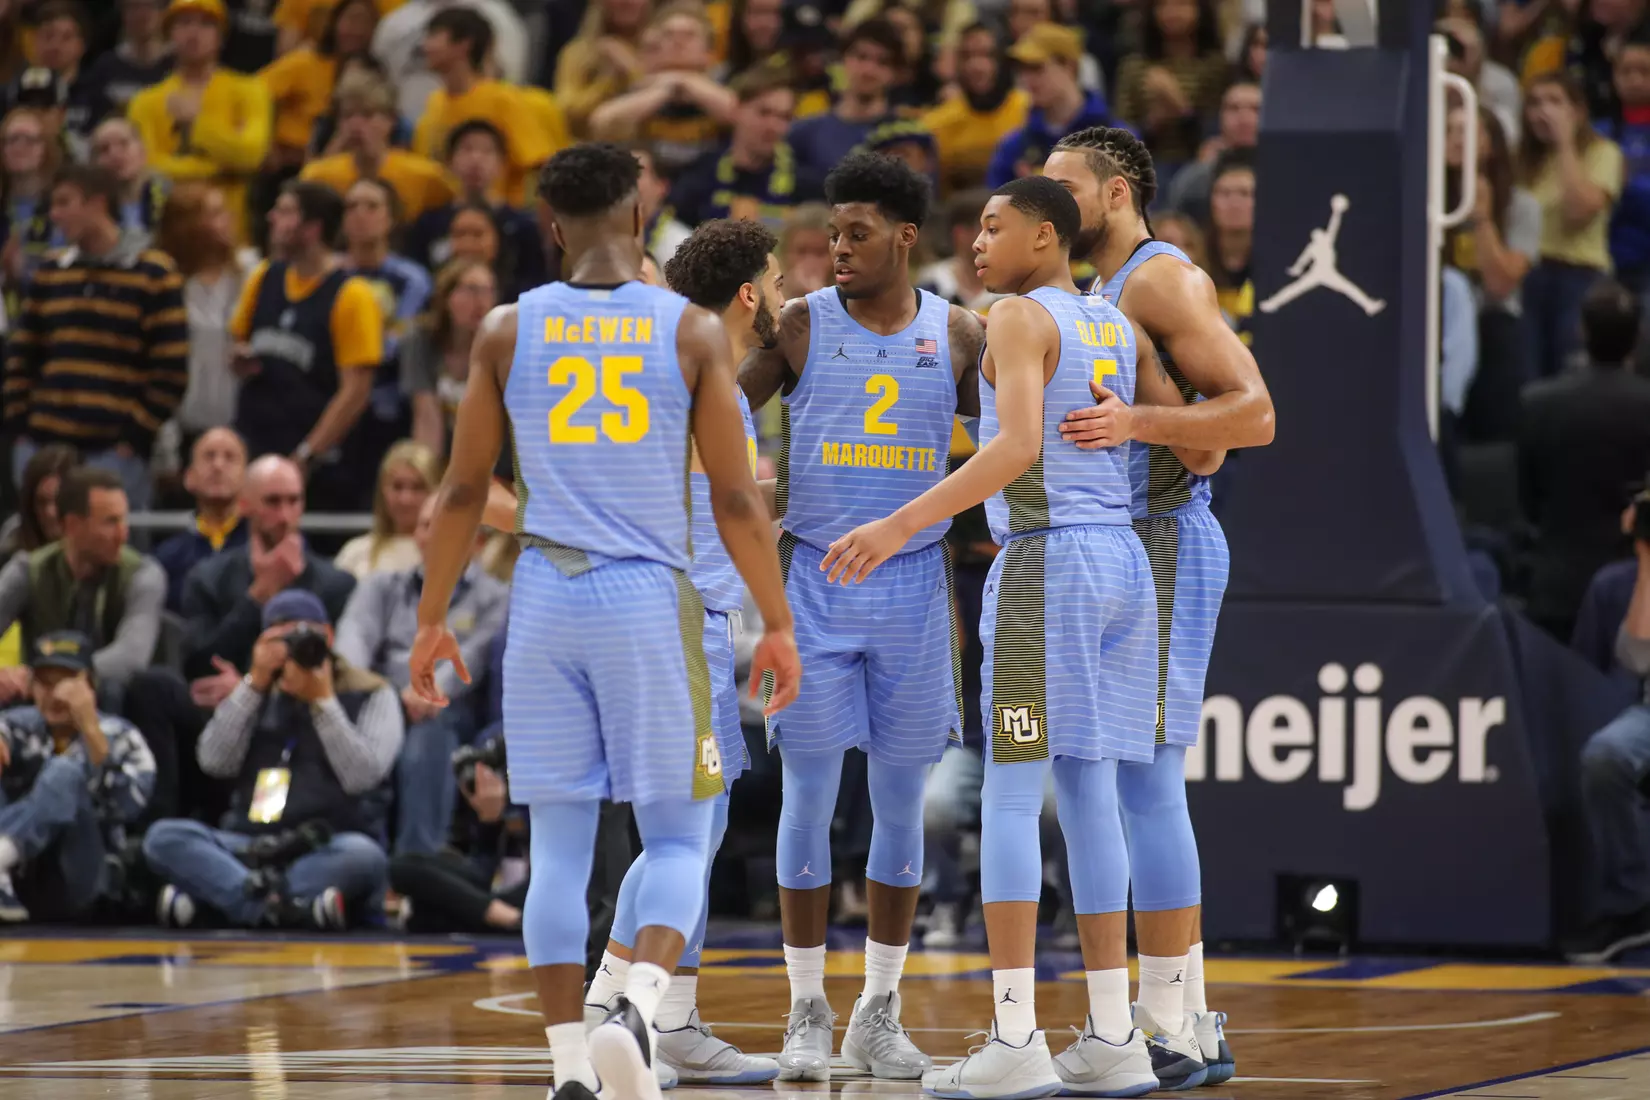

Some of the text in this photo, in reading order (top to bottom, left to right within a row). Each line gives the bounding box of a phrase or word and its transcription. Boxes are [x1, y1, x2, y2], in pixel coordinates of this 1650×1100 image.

[544, 316, 653, 344] McEWEN
[548, 356, 650, 444] 25
[864, 374, 900, 435] 2
[822, 441, 937, 472] MARQUETTE
[998, 705, 1043, 745] MU
